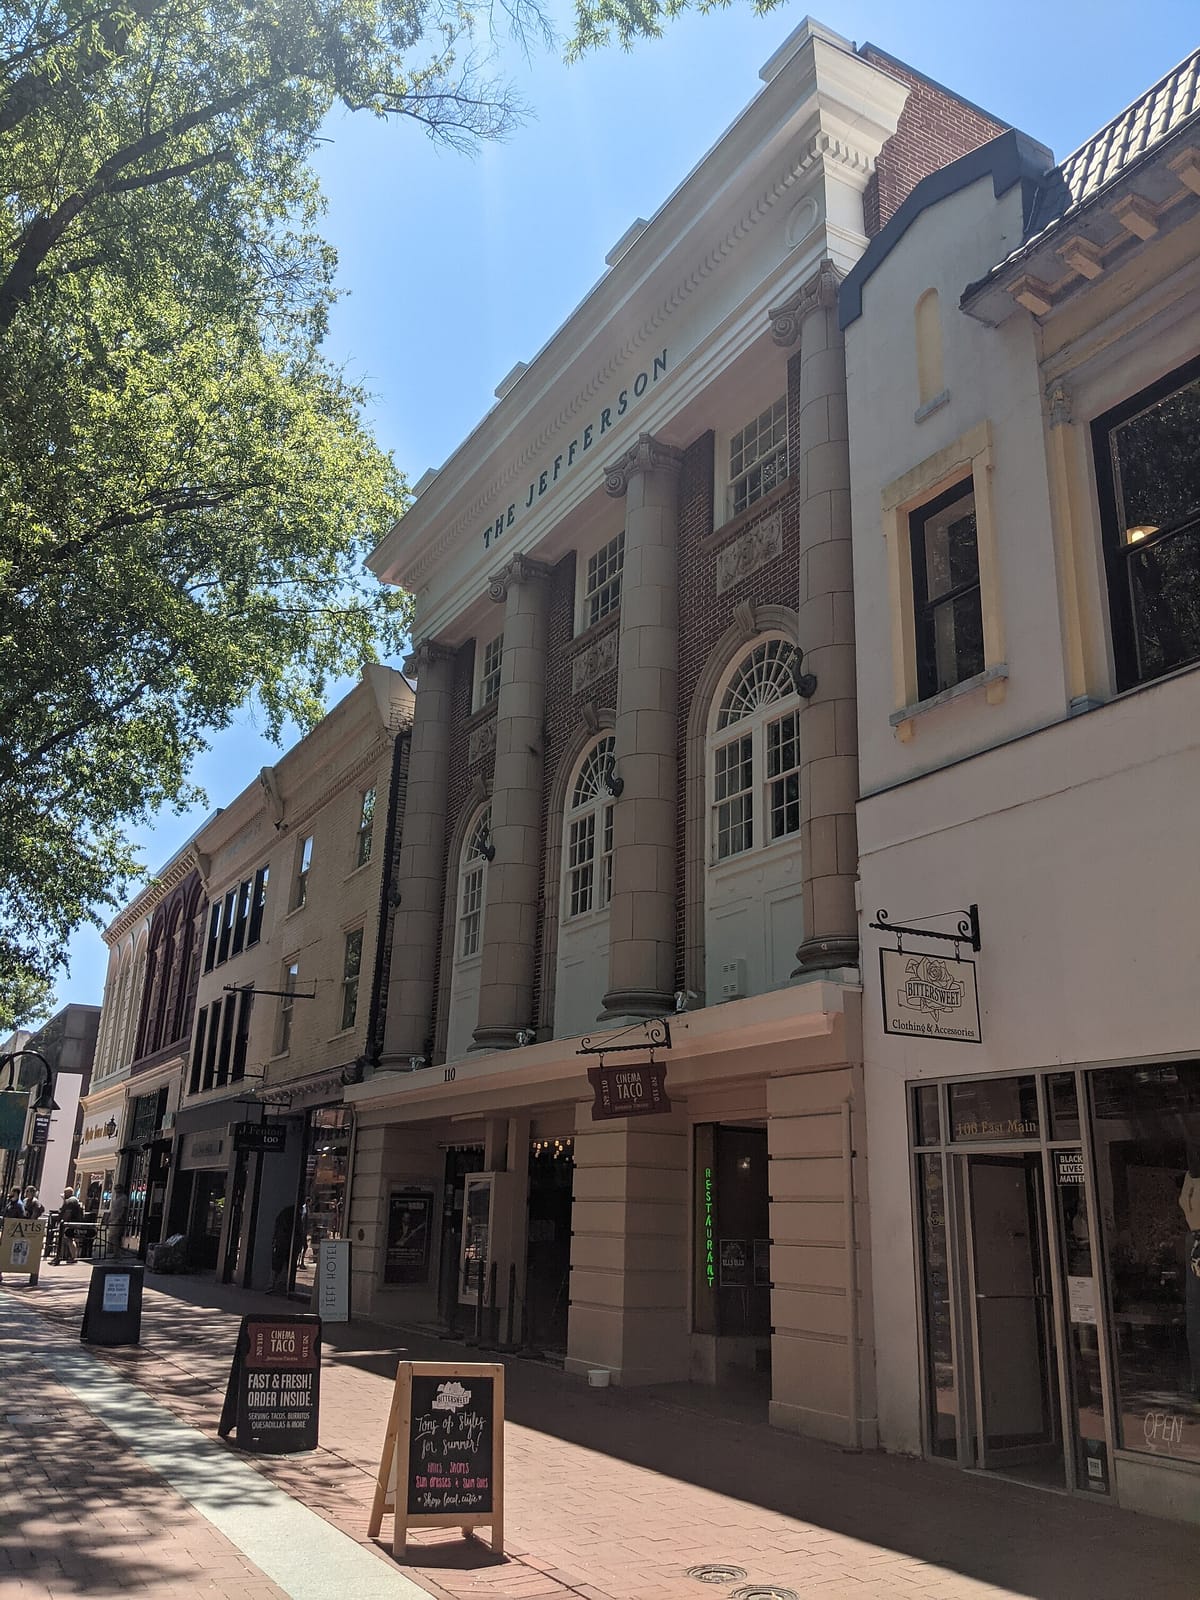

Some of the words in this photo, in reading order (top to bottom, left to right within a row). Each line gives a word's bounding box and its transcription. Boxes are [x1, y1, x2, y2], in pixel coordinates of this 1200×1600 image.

[483, 503, 516, 549] THE
[525, 348, 668, 508] JEFFERSON
[907, 981, 960, 1006] BITTERSWEET
[892, 1019, 926, 1033] Clothing
[926, 1023, 933, 1034] &
[934, 1023, 975, 1037] Accessories
[444, 1067, 456, 1081] 110
[615, 1072, 641, 1084] CINEMA
[616, 1083, 643, 1099] TACO
[1007, 1119, 1036, 1133] Main
[263, 1135, 279, 1143] too
[1059, 1154, 1083, 1163] BLACK
[1062, 1164, 1083, 1172] LIVES
[10, 1221, 42, 1238] Arts
[705, 1168, 714, 1288] RESTAURANT
[326, 1243, 337, 1280] HOTEL
[326, 1285, 336, 1306] JEFF
[270, 1330, 296, 1340] CINEMA
[270, 1339, 295, 1353] TACO
[247, 1373, 271, 1389] FAST
[271, 1373, 280, 1388] &
[281, 1373, 313, 1389] FRESH!
[247, 1391, 277, 1407] ORDER
[280, 1391, 313, 1407] INSIDE.
[248, 1412, 270, 1420] SERVING
[251, 1420, 286, 1429] QUESADILLAS
[415, 1413, 440, 1436] Tons
[442, 1415, 454, 1434] of
[1143, 1412, 1184, 1443] OPEN
[421, 1439, 438, 1460] for
